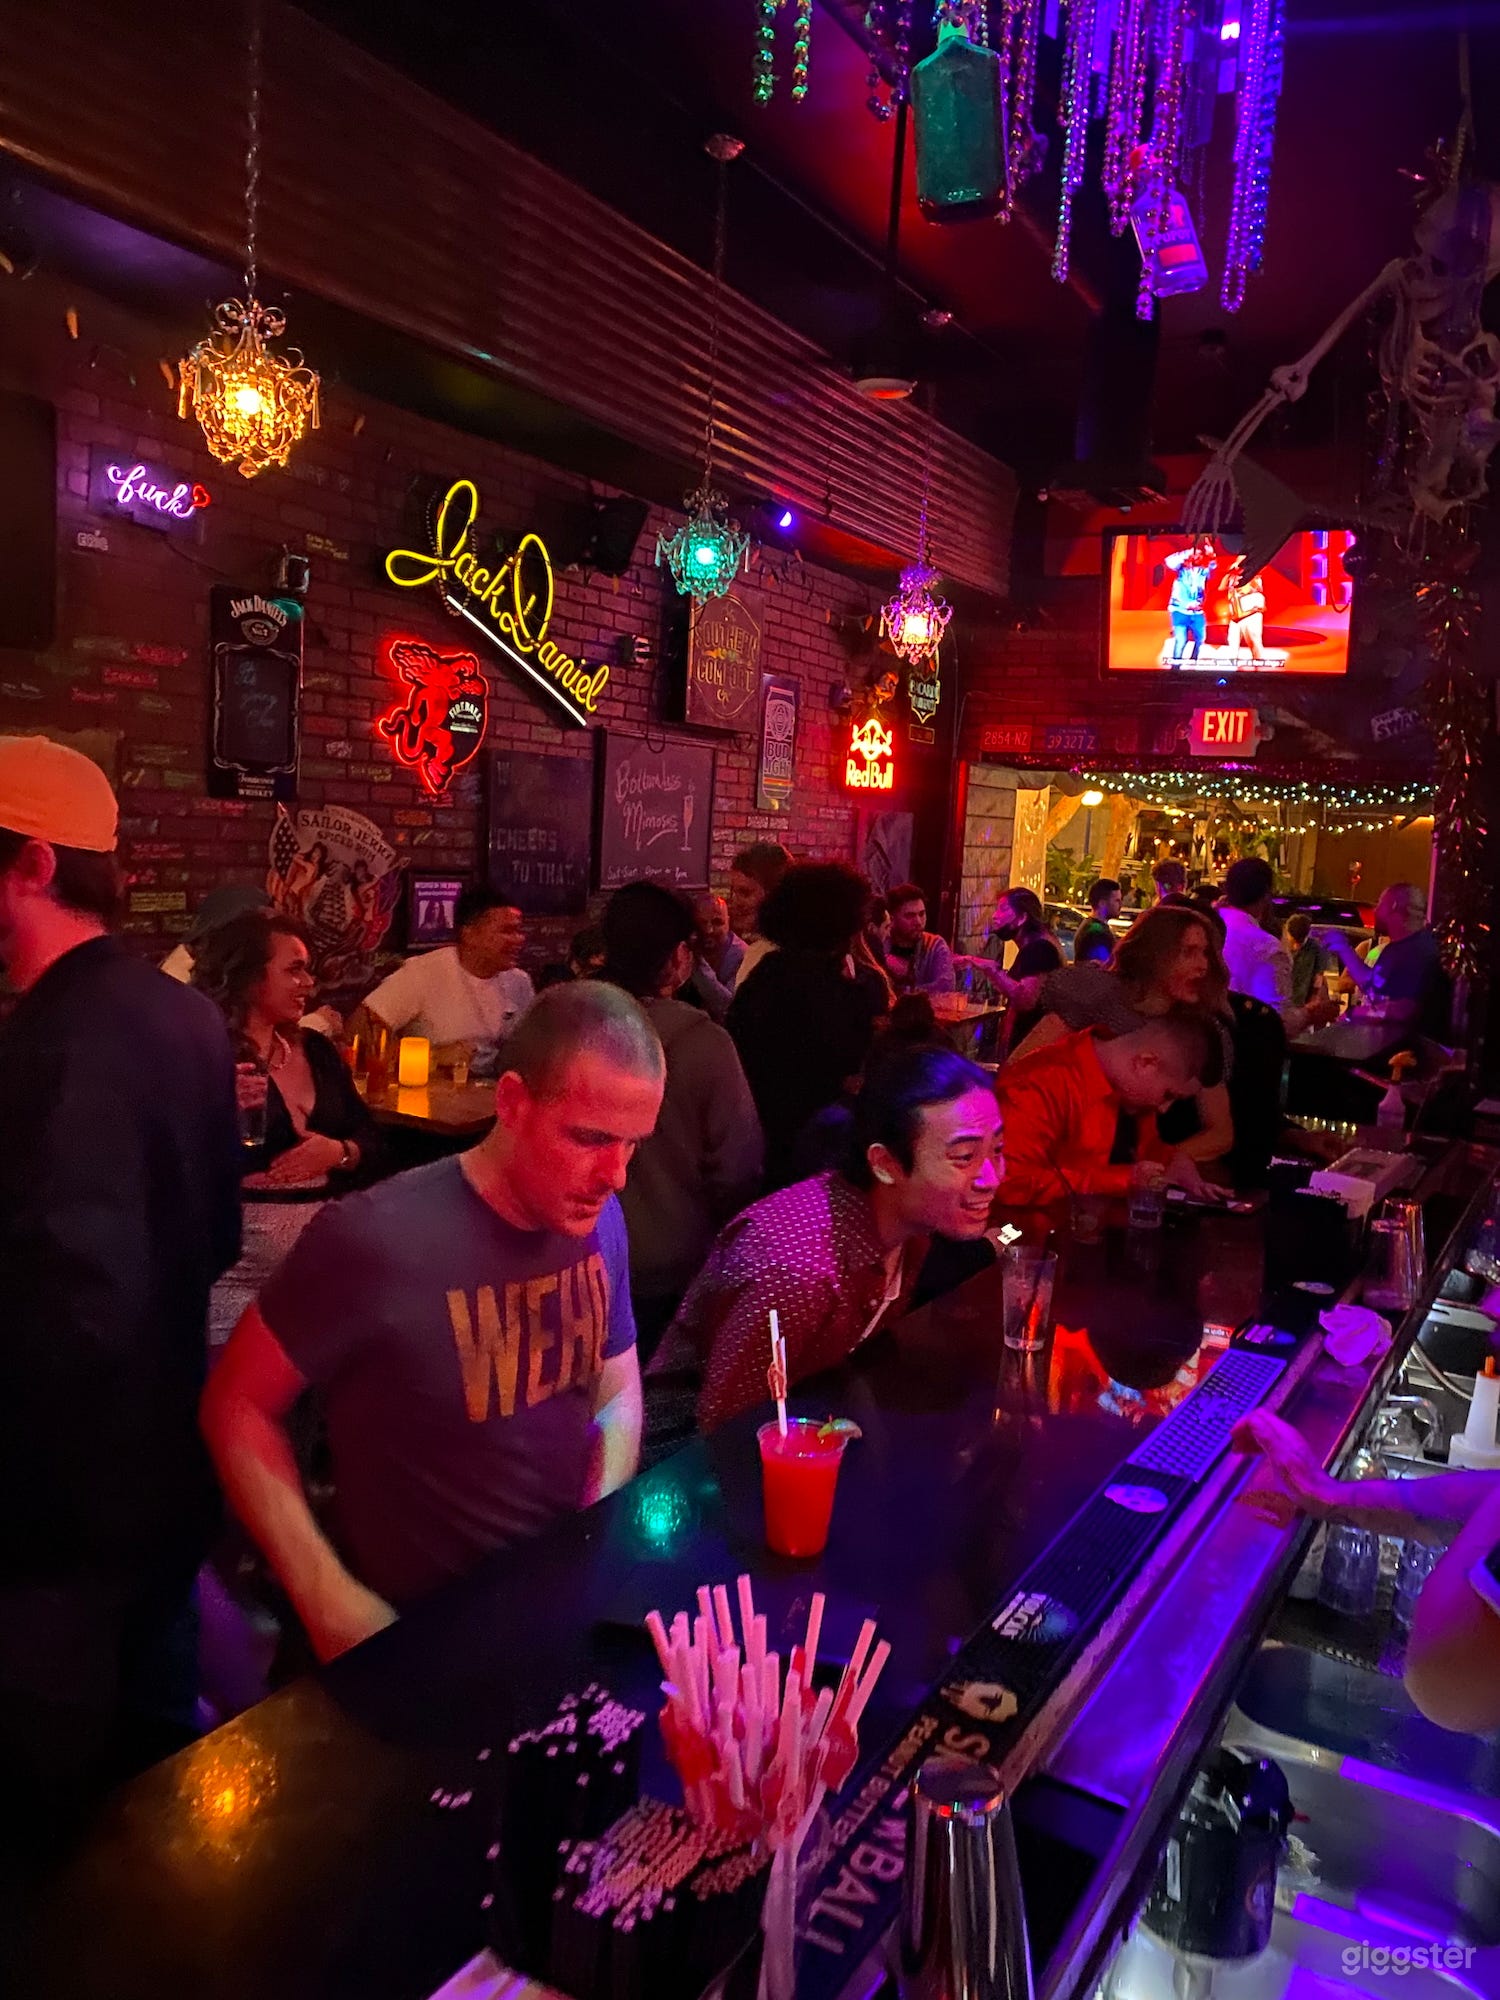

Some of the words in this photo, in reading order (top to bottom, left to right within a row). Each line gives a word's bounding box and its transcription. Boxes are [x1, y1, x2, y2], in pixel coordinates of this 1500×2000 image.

[108, 465, 194, 519] fuck
[230, 598, 254, 619] JACK
[385, 479, 512, 618] Jack
[499, 533, 609, 711] Daniel
[694, 620, 758, 662] SOUTHERN
[448, 701, 482, 722] FIREBALL
[1203, 711, 1248, 743] EXIT
[766, 740, 791, 759] BUD
[764, 757, 792, 776] LIGHT
[846, 759, 870, 787] Red
[871, 762, 894, 789] Bull
[238, 788, 274, 798] WHISKEY
[301, 814, 351, 836] SAILOR
[354, 829, 393, 860] JERRY
